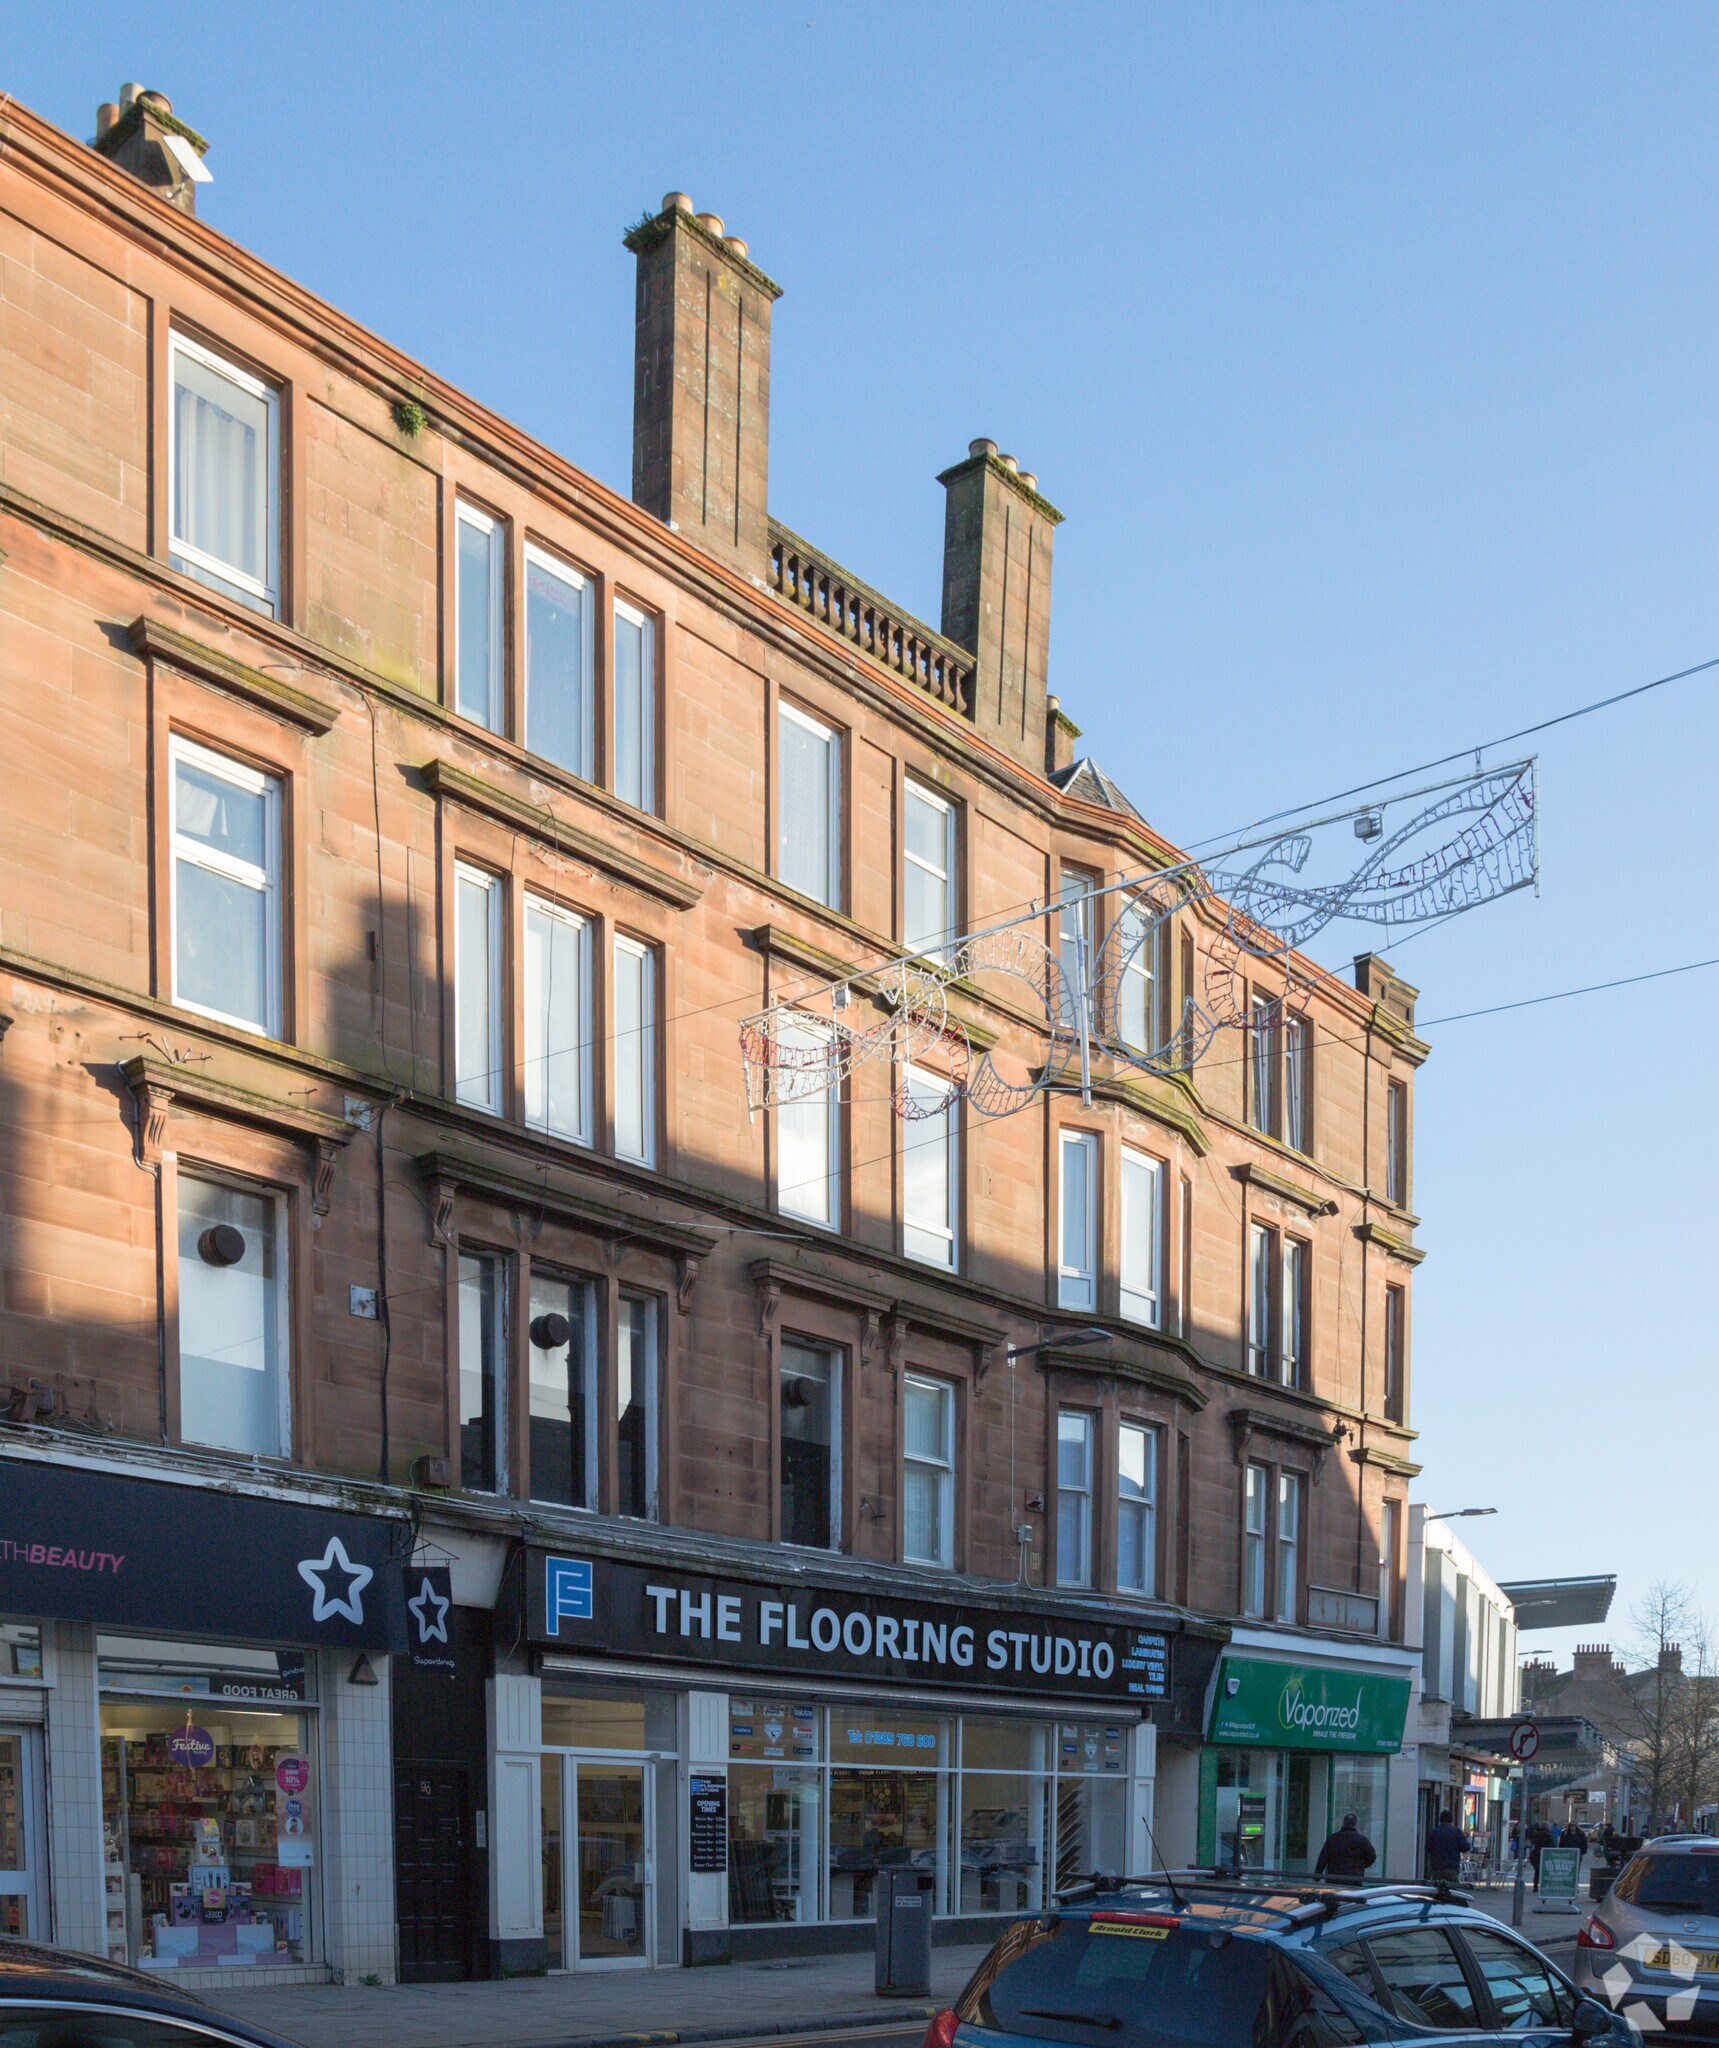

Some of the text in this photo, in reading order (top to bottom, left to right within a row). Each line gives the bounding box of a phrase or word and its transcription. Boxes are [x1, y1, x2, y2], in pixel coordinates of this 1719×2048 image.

[646, 1585, 1115, 1680] THE FLOORING STUDIO
[412, 1655, 456, 1669] Superdrug
[1285, 1686, 1363, 1731] Vaporized
[847, 1729, 863, 1743] Tel:
[864, 1730, 895, 1745] 01389
[1094, 1925, 1163, 1937] Arnold Clark
[1652, 1951, 1690, 1966] SD60
